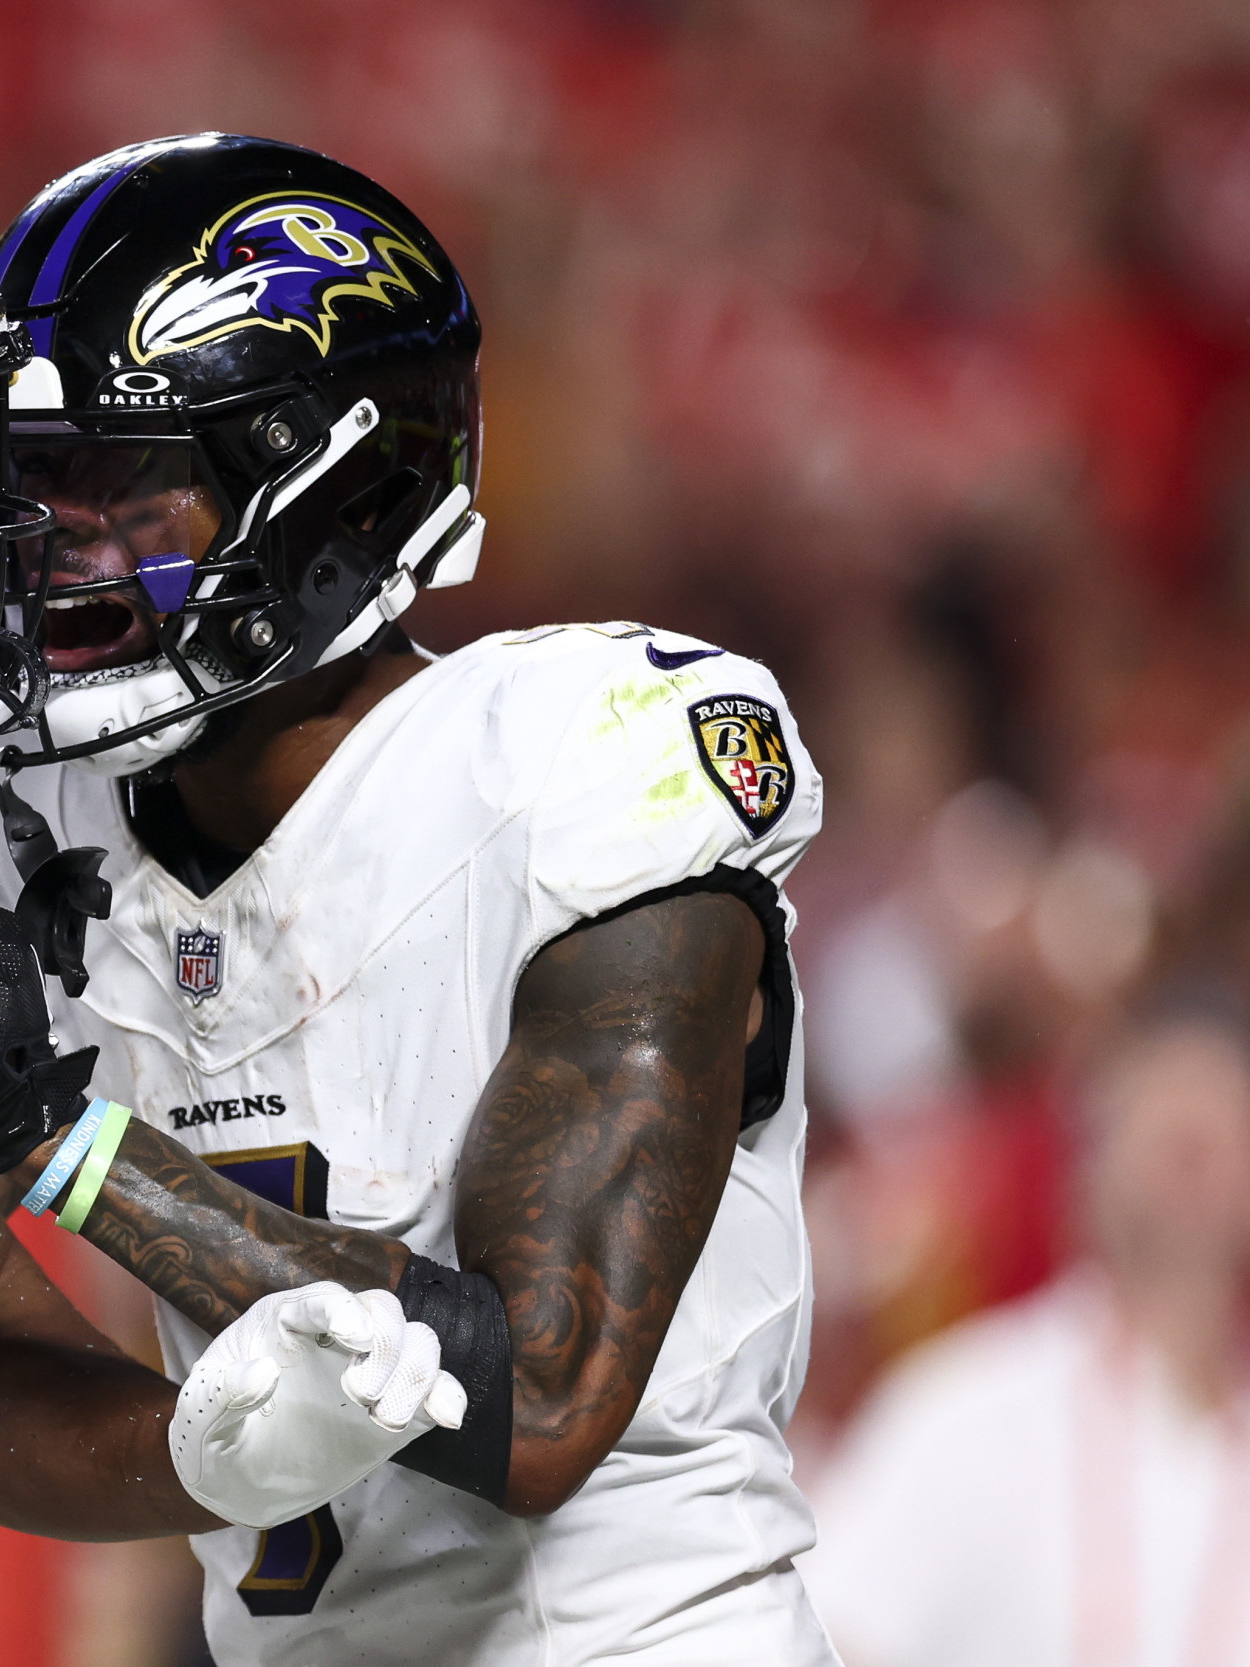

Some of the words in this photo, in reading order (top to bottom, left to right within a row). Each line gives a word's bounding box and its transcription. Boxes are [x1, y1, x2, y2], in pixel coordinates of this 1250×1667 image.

[233, 204, 370, 267] B
[99, 394, 183, 406] OAKLEY
[694, 700, 772, 722] RAVENS
[703, 719, 748, 760] B
[180, 956, 214, 989] NFL
[168, 1095, 287, 1130] RAVENS
[55, 1114, 103, 1173] KINDNESS
